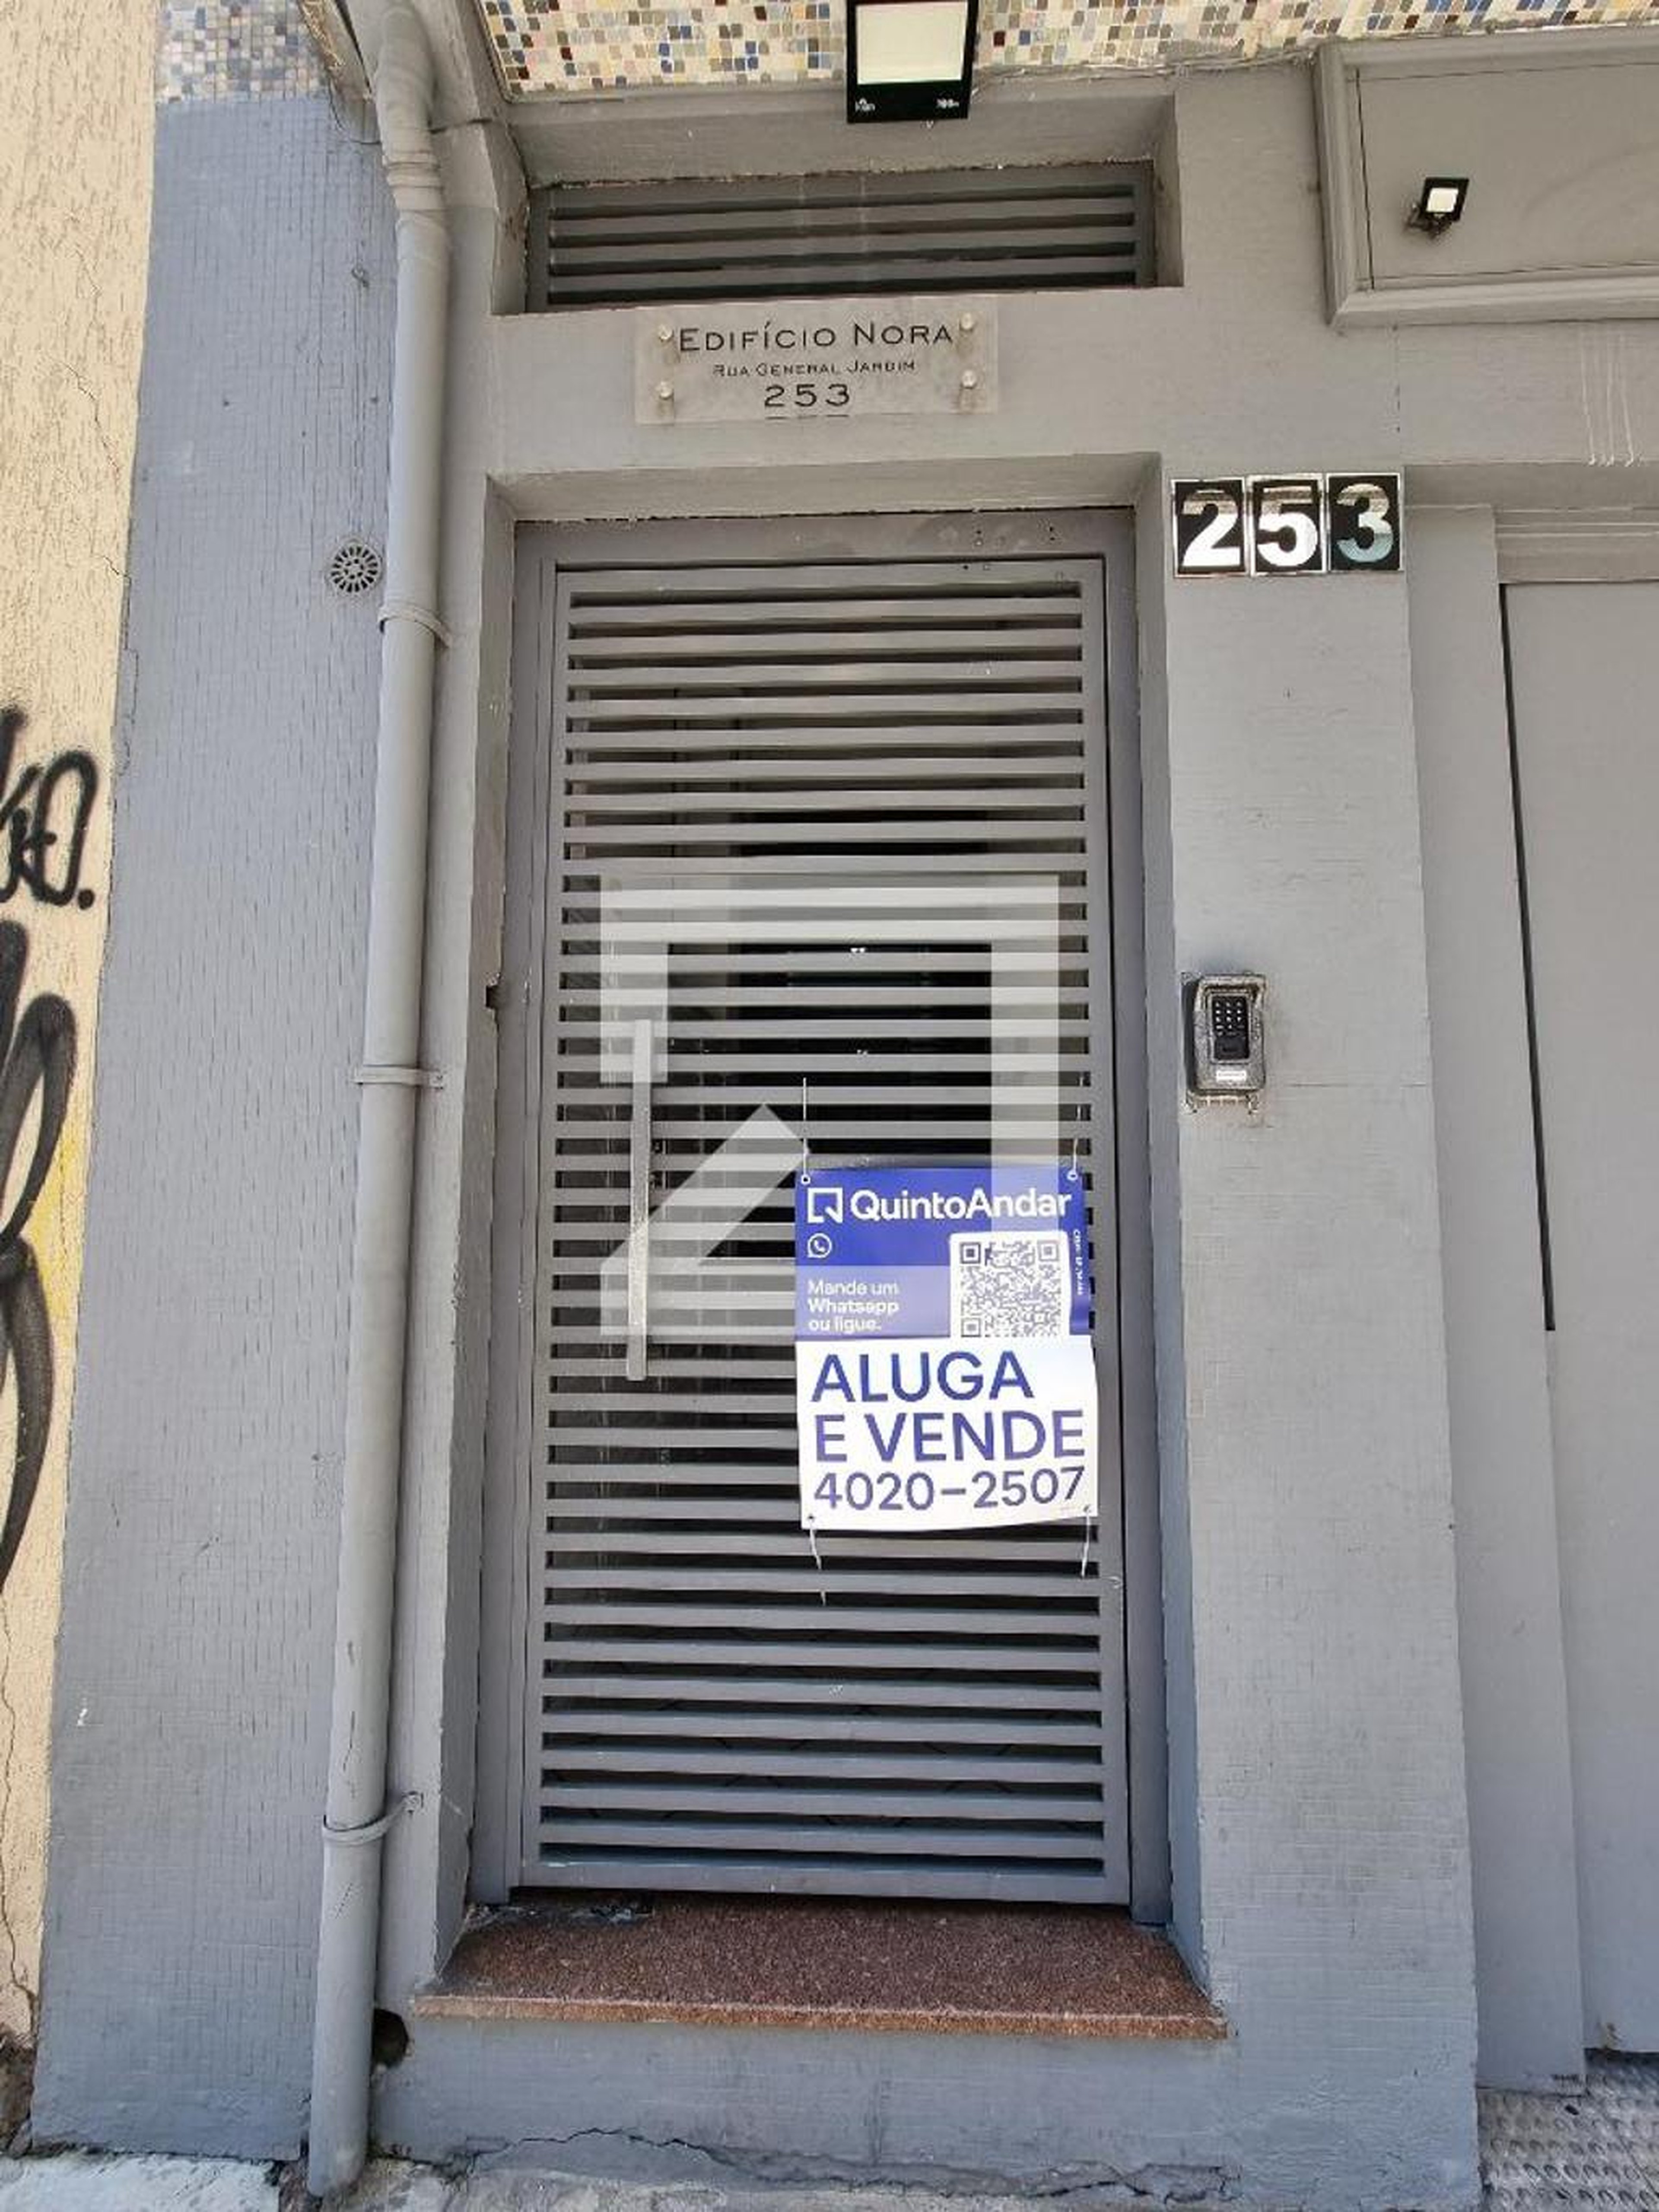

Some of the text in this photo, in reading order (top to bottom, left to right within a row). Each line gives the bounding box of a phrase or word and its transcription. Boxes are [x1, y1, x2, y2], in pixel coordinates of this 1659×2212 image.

[680, 321, 953, 352] EDIFÍCIO NORA
[713, 359, 915, 378] RUA GENERAL JARDIM
[764, 383, 850, 407] 253
[1180, 482, 1395, 567] 253
[850, 1187, 1071, 1220] QuintoAndar
[807, 1279, 900, 1295] Mande um
[807, 1298, 899, 1316] Whatsapp
[808, 1316, 883, 1334] ou ligue.
[811, 1351, 1034, 1403] ALUGA
[815, 1410, 1085, 1463] E VENDE
[814, 1466, 1085, 1511] 4020-2507
